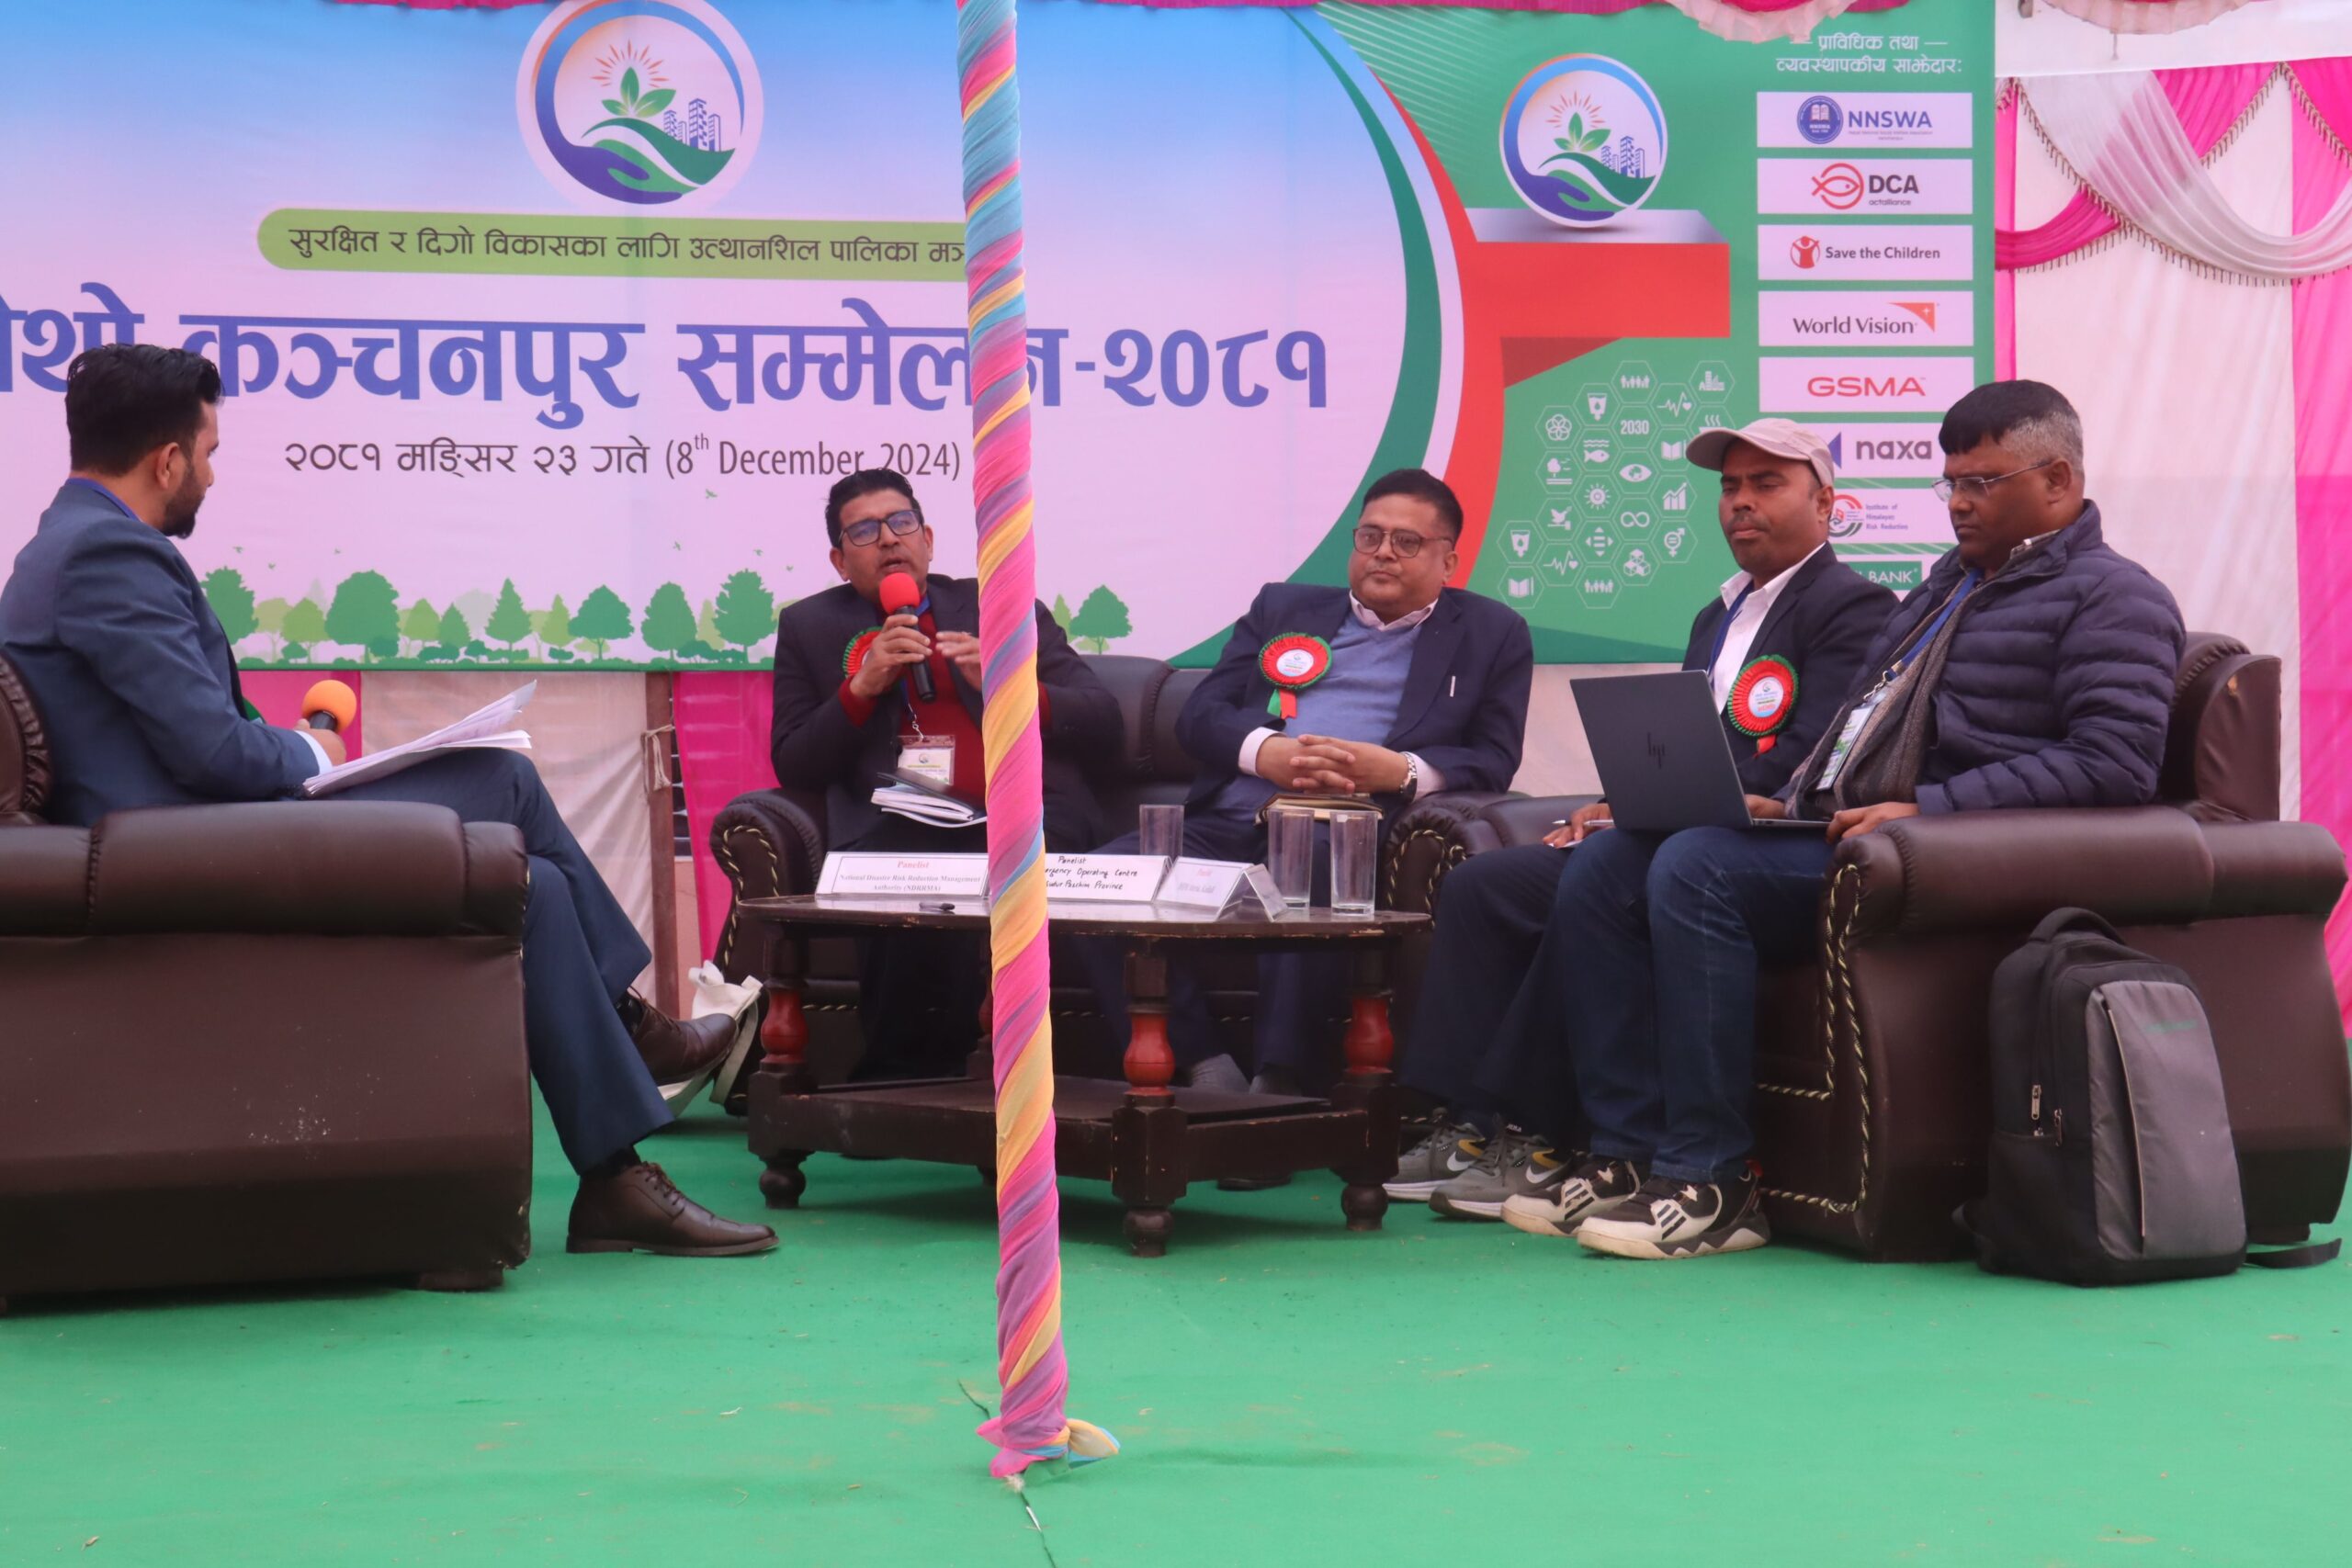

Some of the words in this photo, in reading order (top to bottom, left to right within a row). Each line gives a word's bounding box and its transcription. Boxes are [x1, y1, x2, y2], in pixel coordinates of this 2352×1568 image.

[1818, 32, 1883, 51] प्राविधिक
[1889, 35, 1919, 51] तथा
[1776, 55, 1887, 73] व्यवस्थापकीय
[1849, 110, 1932, 128] NNSWA
[1869, 175, 1919, 194] DCA
[288, 225, 379, 258] सुरक्षित
[388, 231, 407, 254] र
[417, 225, 474, 255] दिगो
[484, 229, 606, 257] विकासका
[616, 231, 681, 258] लागि
[689, 233, 820, 262] उत्थानशिल
[830, 235, 919, 263] पालिका
[1826, 246, 1856, 259] Save
[1860, 246, 1881, 259] the
[1884, 246, 1940, 259] Children
[1792, 316, 1850, 334] World
[1855, 317, 1915, 334] Vision
[1807, 377, 1926, 397] GSMA
[1621, 420, 1649, 434] 2030
[285, 443, 380, 471] २०८१
[533, 445, 577, 476] २३
[591, 434, 650, 474] गते
[720, 441, 864, 475] December
[879, 443, 961, 480] 2024)
[1856, 441, 1932, 460] naxa
[1869, 570, 1912, 584] BANK
